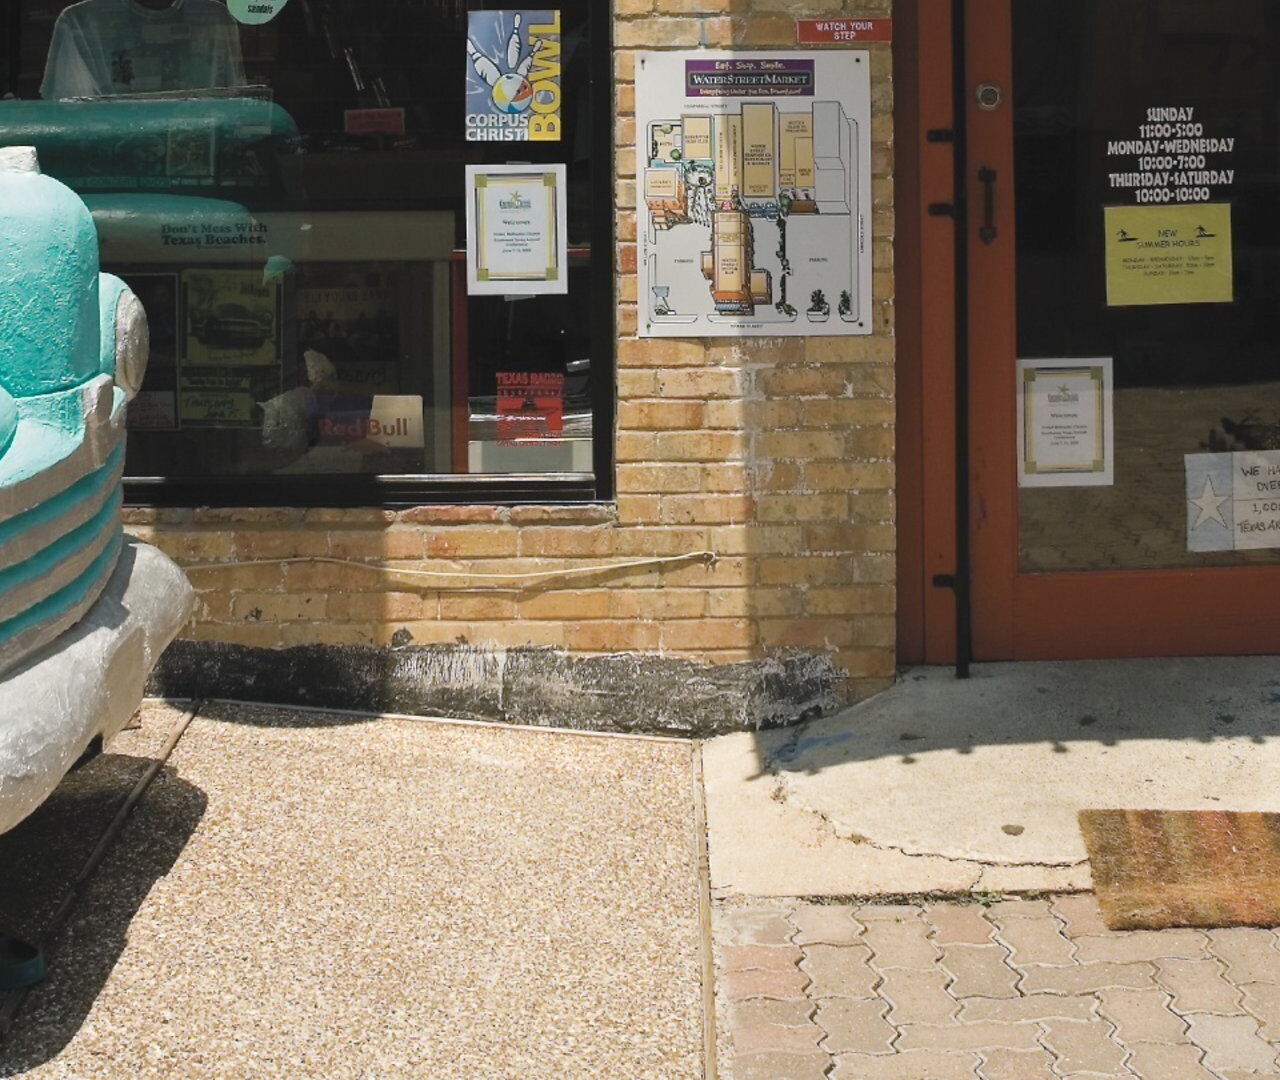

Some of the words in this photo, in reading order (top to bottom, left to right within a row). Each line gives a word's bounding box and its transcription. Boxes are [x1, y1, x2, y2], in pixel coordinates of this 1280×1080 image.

[815, 22, 847, 31] WATCH
[851, 22, 873, 31] YOUR
[833, 30, 856, 40] STEP
[528, 10, 561, 141] BOWL
[466, 114, 529, 127] CORPUS
[1146, 107, 1195, 122] SUNDAY
[466, 128, 529, 141] CHRISTI
[1138, 123, 1204, 139] 11:00-5:00
[1106, 138, 1235, 156] MONDAY-WEDNESDAY
[1137, 155, 1206, 172] 10:00-7:00
[1108, 170, 1235, 188] THURSDAY-SATURDAY
[1134, 187, 1211, 203] 10:00-10:00
[161, 224, 198, 235] Don't
[201, 223, 232, 235] Mess
[235, 222, 268, 234] With
[1158, 229, 1178, 238] NEW
[161, 235, 202, 247] Texas
[205, 234, 266, 246] Beaches.
[1136, 240, 1171, 249] SUMMER
[1172, 239, 1201, 248] HOURS
[318, 419, 364, 436] Red
[368, 417, 409, 436] Bull
[1241, 465, 1261, 477] WE
[1236, 519, 1267, 534] TEXAS
